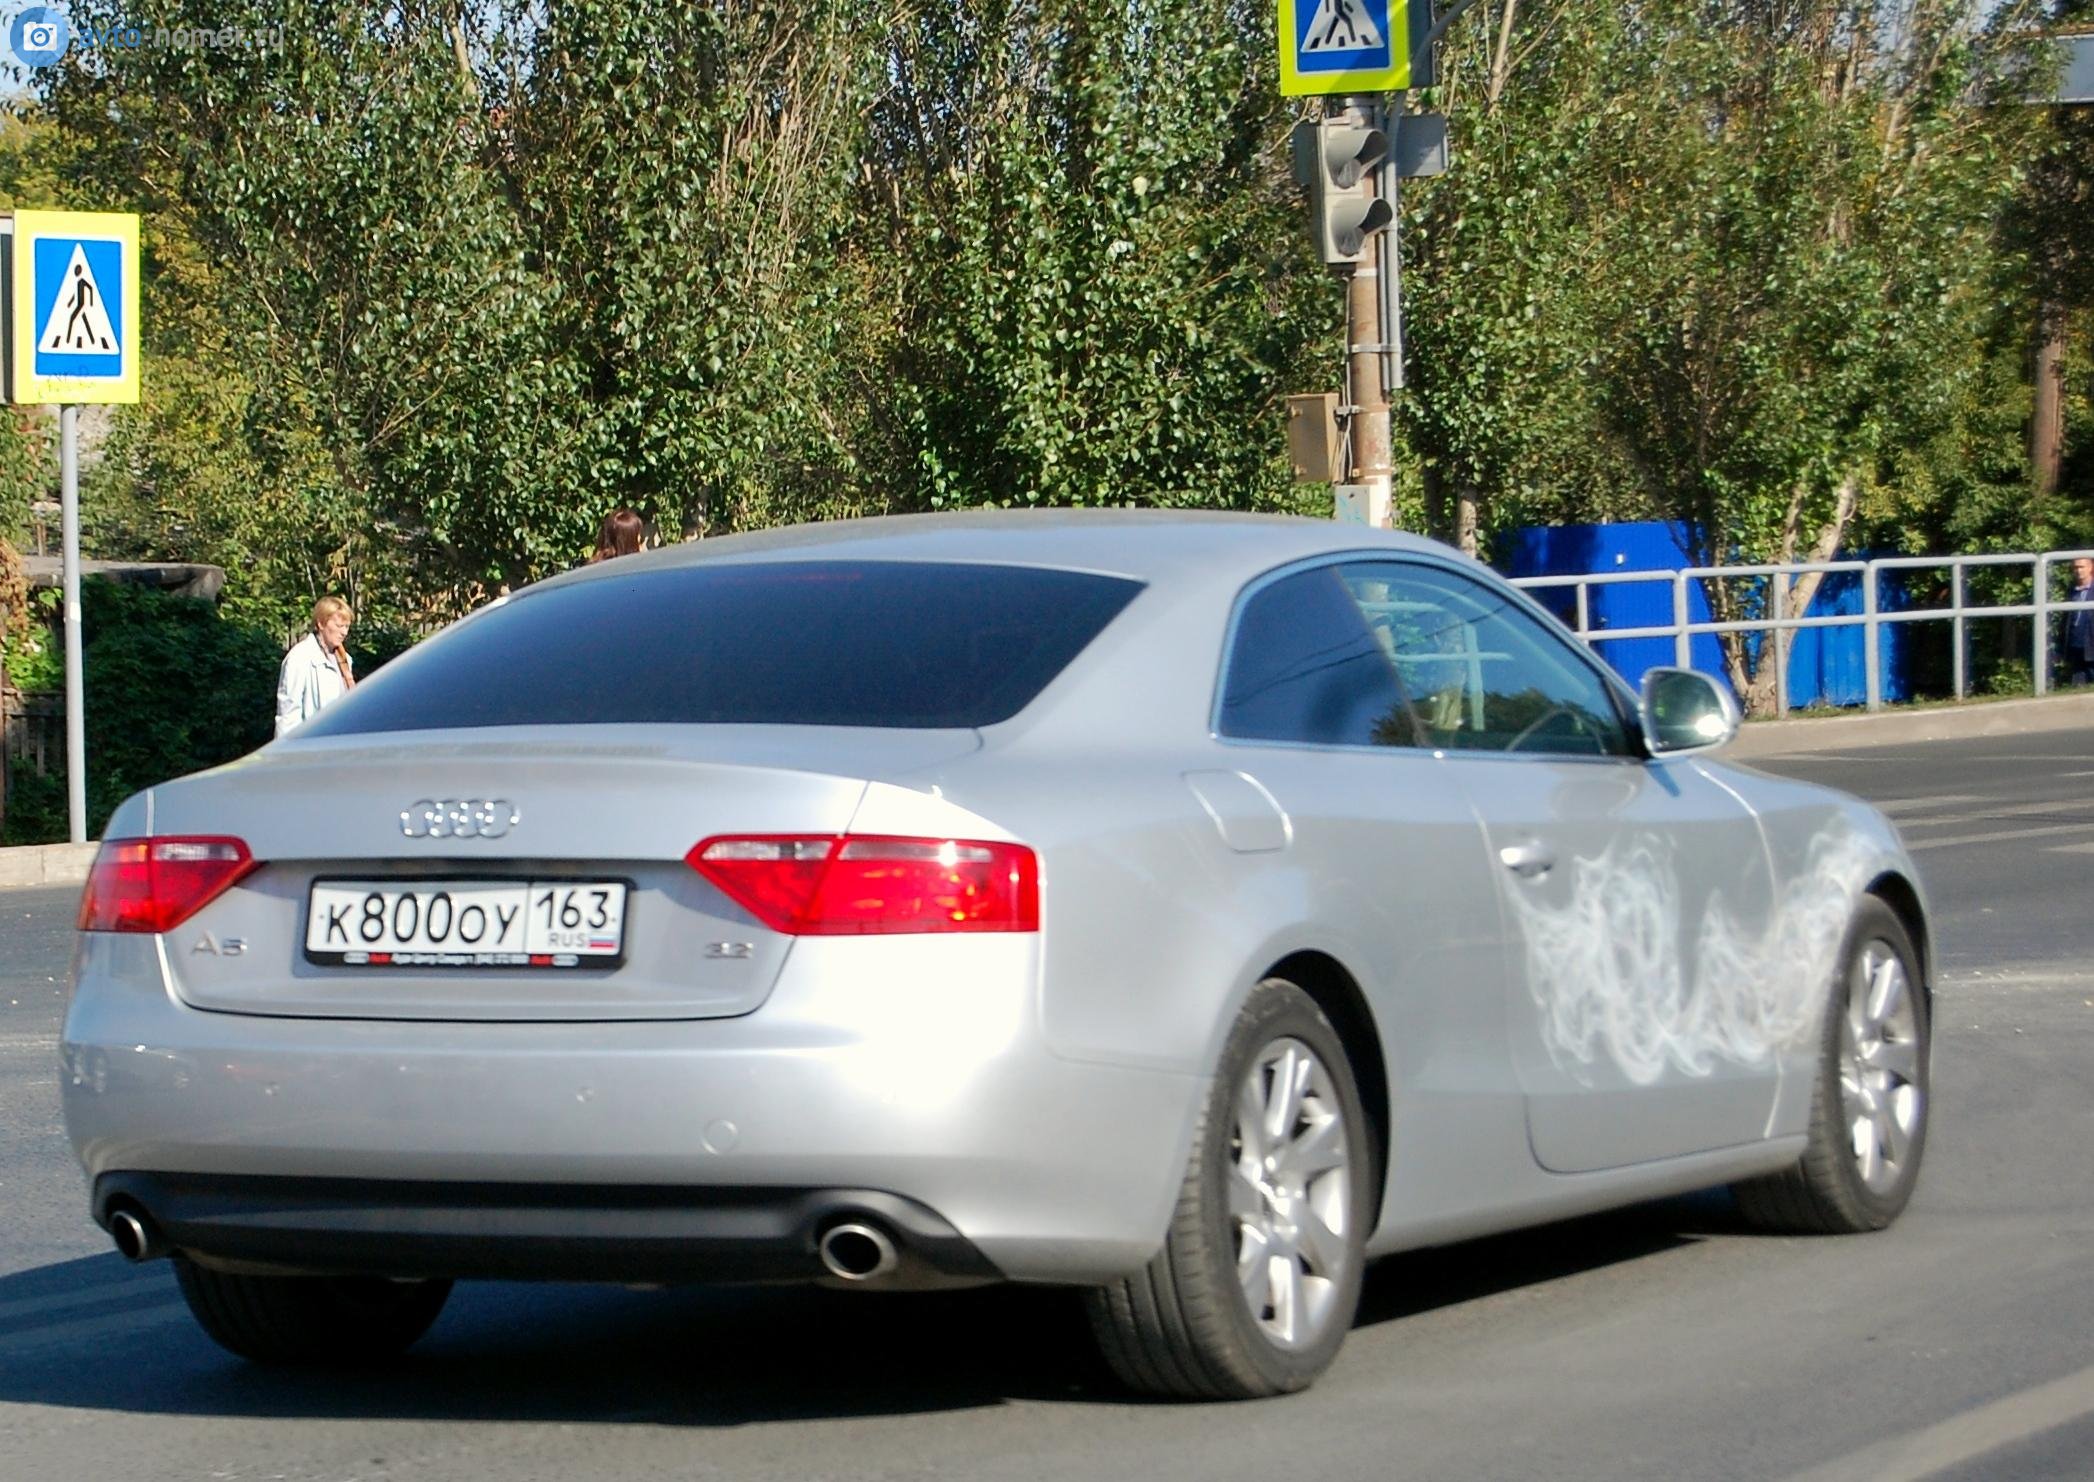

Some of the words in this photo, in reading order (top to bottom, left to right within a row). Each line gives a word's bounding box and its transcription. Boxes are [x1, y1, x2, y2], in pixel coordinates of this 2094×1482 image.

[536, 890, 609, 929] 163
[191, 929, 248, 957] A5
[548, 932, 586, 948] RUS
